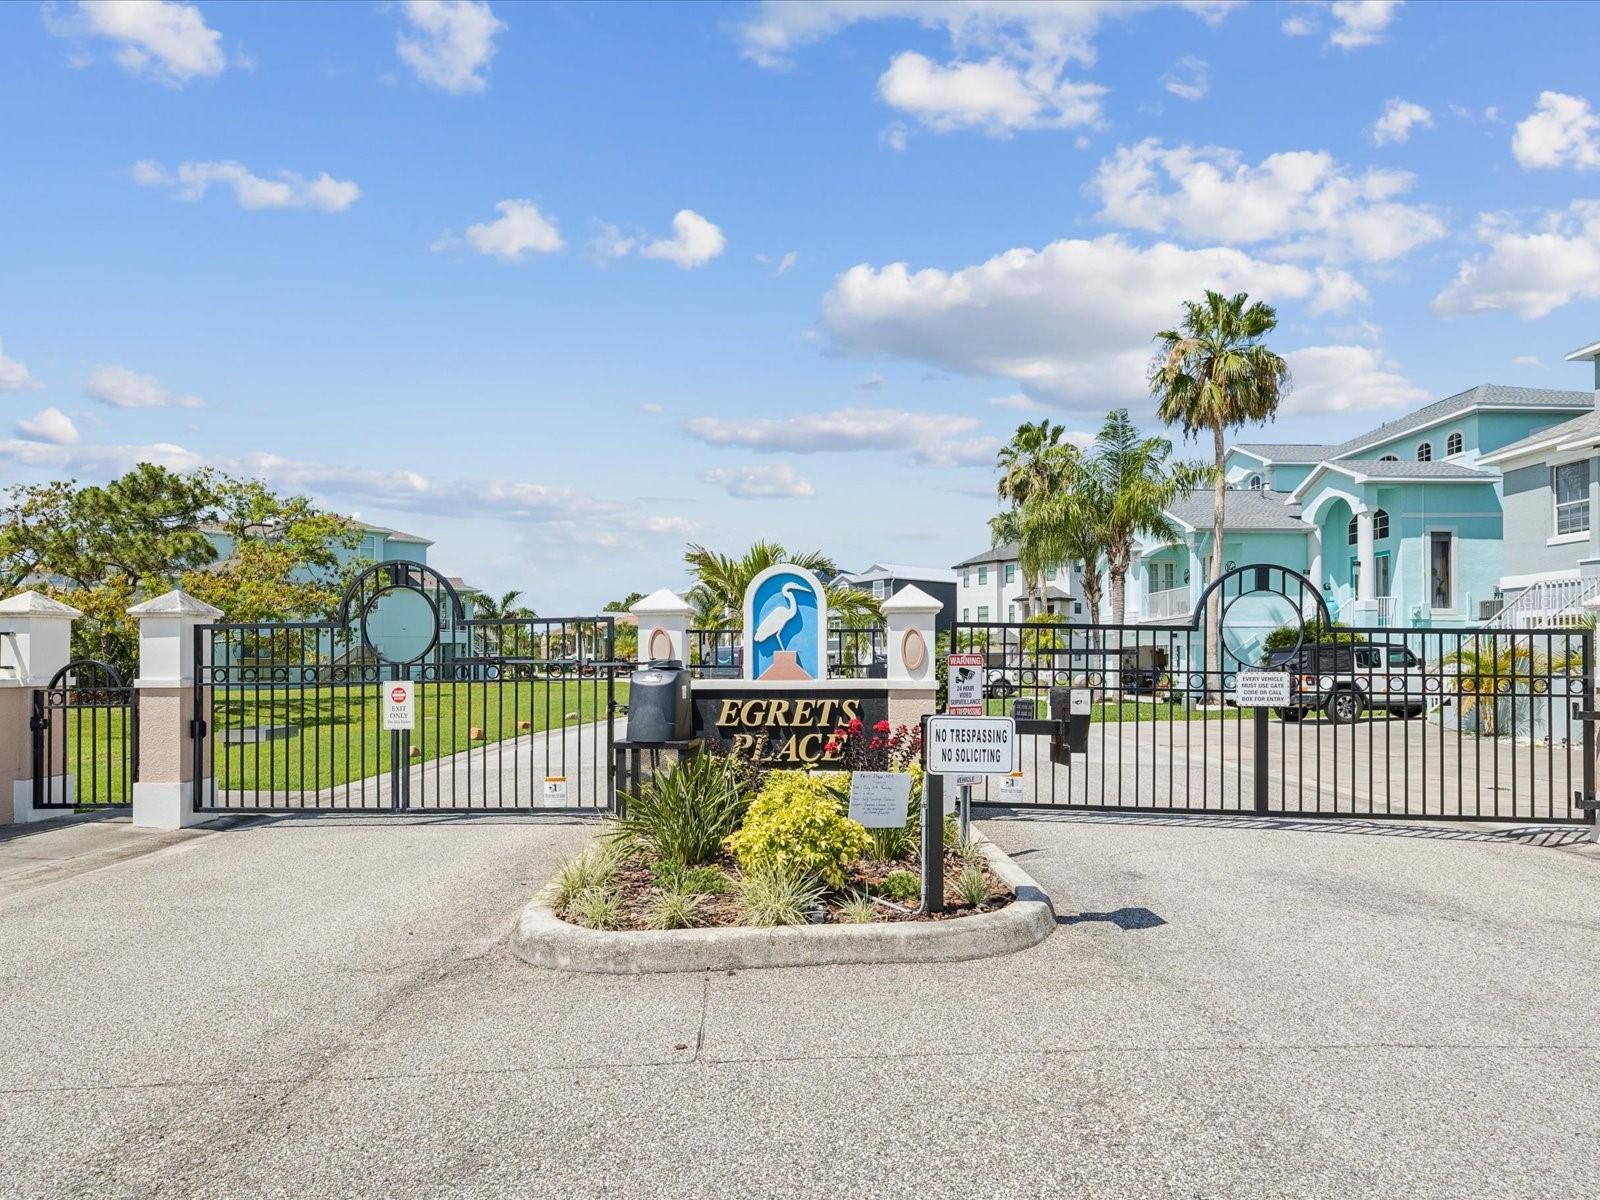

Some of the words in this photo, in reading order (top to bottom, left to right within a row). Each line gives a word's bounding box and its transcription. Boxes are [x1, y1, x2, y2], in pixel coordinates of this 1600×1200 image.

[950, 656, 981, 665] WARNING
[715, 699, 860, 728] EGRETS
[935, 729, 947, 742] NO
[950, 729, 1008, 743] TRESPASSING
[729, 733, 848, 762] PLACE
[941, 748, 953, 762] NO
[955, 748, 1001, 763] SOLICITING
